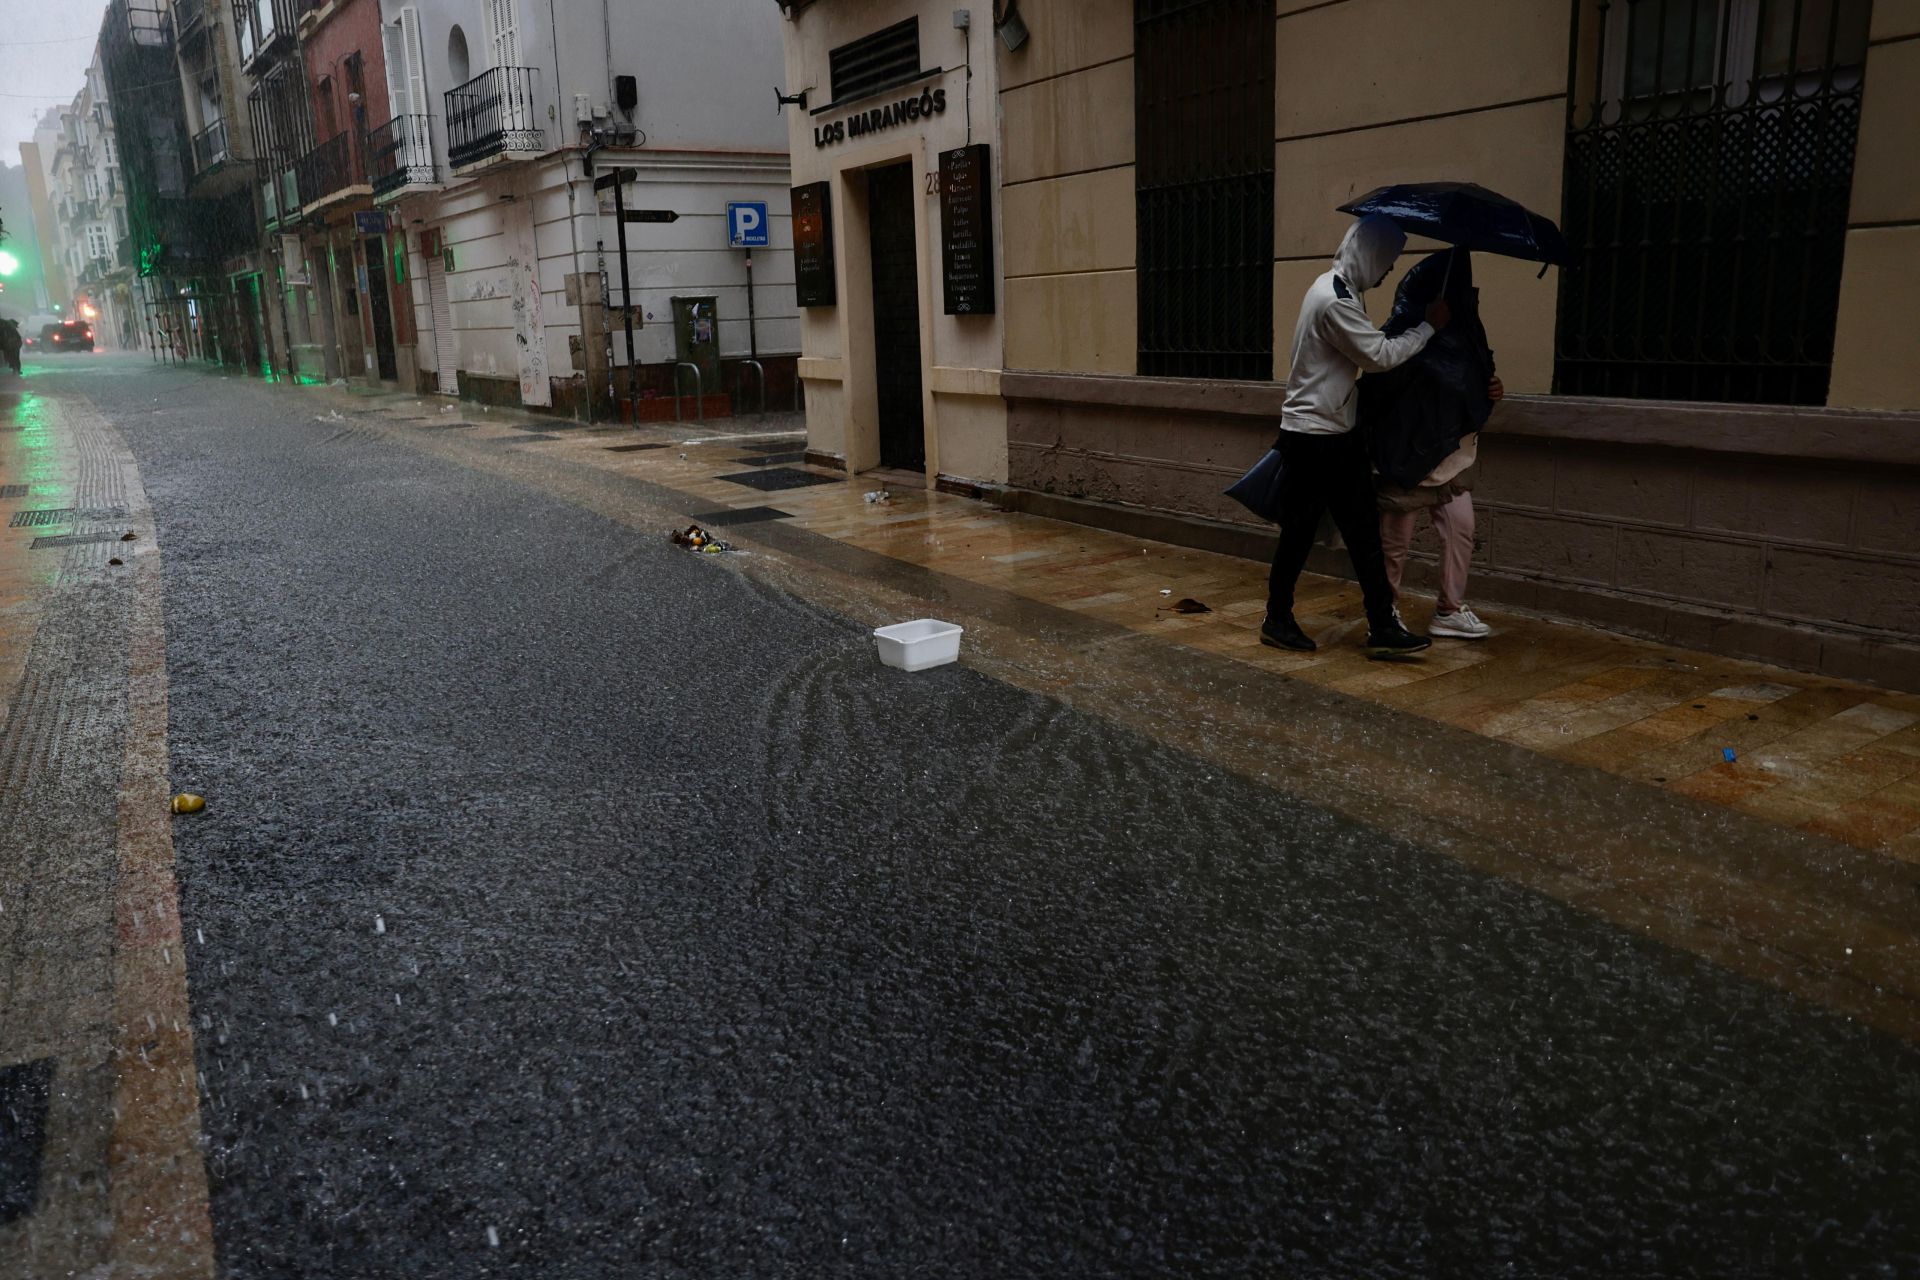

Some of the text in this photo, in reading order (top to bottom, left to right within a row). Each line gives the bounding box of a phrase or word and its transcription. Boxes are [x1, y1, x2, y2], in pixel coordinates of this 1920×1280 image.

[814, 86, 947, 147] LOS MARANGÓS
[926, 171, 941, 195] 28
[735, 207, 760, 241] P
